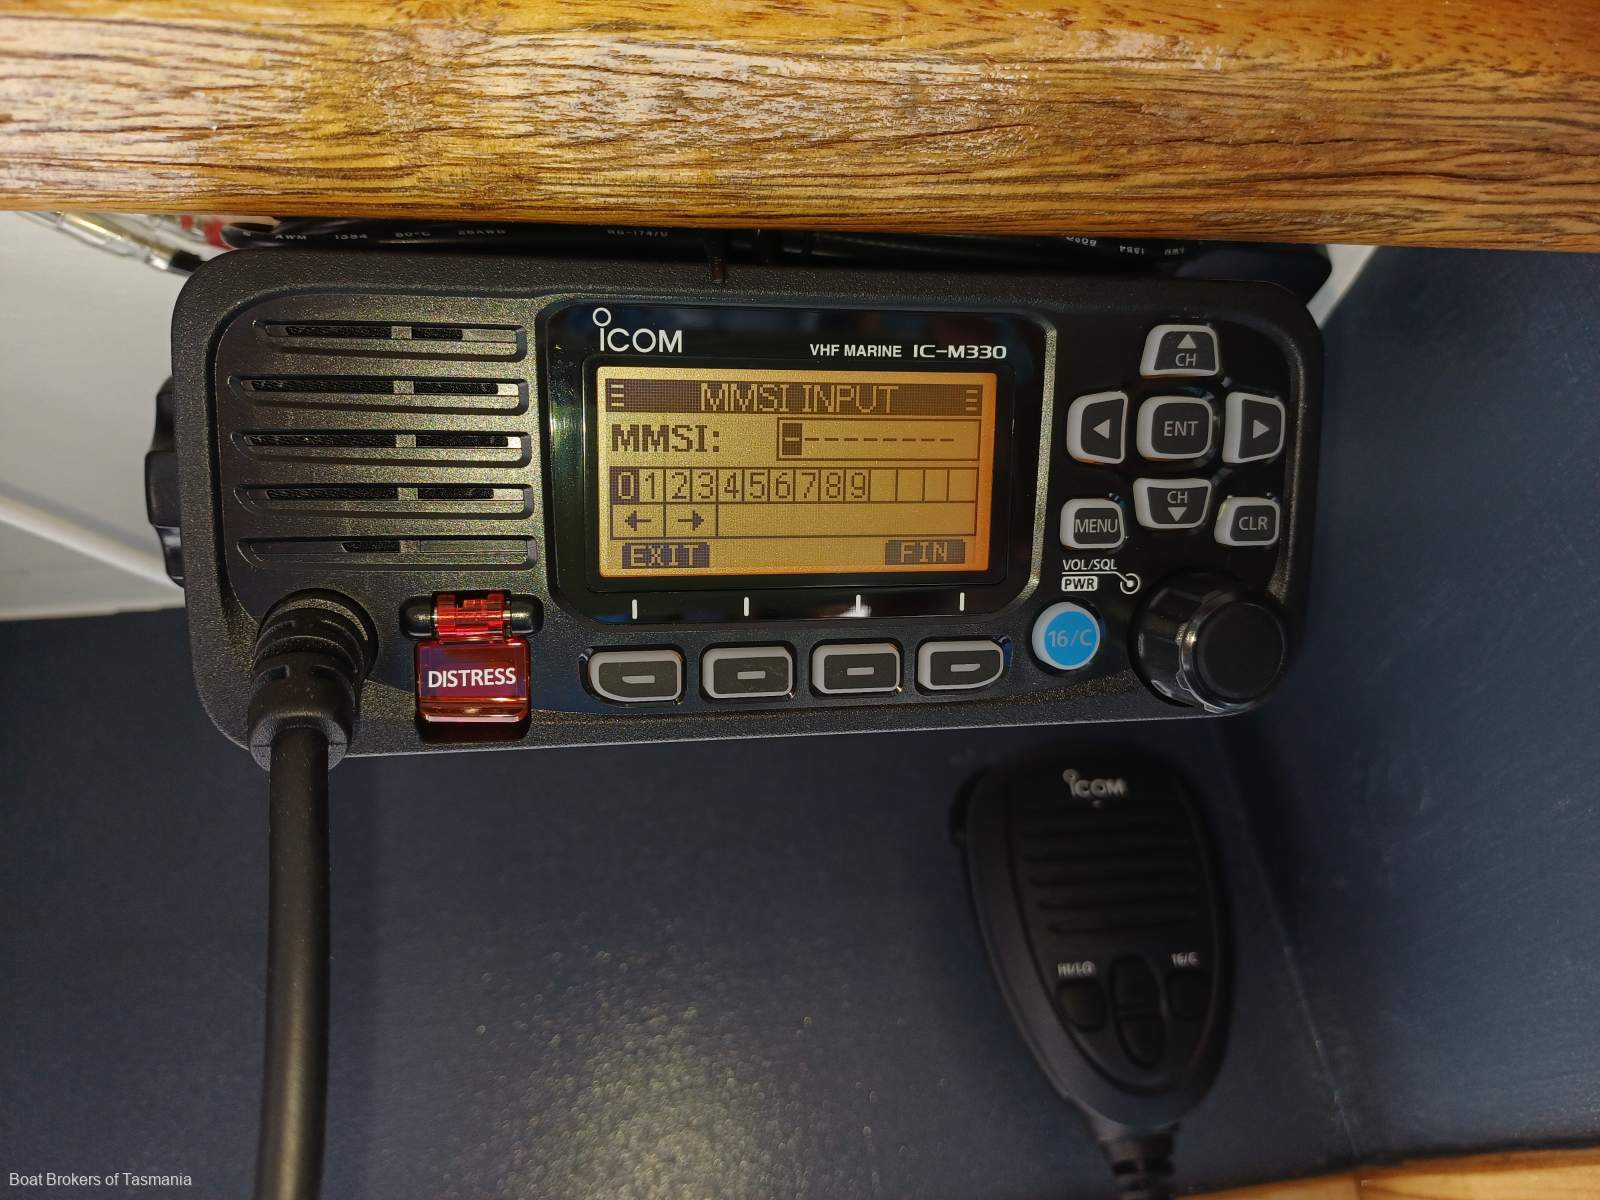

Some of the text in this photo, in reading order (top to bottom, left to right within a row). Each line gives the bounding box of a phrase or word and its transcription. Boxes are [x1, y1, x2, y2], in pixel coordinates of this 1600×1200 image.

[809, 343, 1008, 360] VHF MARINE IC-M330
[1174, 353, 1197, 368] CH
[700, 383, 899, 415] MMSI INPUT
[1163, 420, 1200, 438] ENT
[611, 424, 721, 454] MMSI:
[1166, 490, 1188, 504] CH
[1074, 518, 1119, 534] MENU
[1238, 516, 1268, 531] CLR
[629, 544, 700, 568] EXIT
[899, 541, 950, 564] FIN
[1062, 558, 1118, 572] VOL/SQL
[1063, 577, 1096, 591] PWR
[1047, 628, 1093, 648] 16/C
[428, 667, 517, 688] DISTRESS
